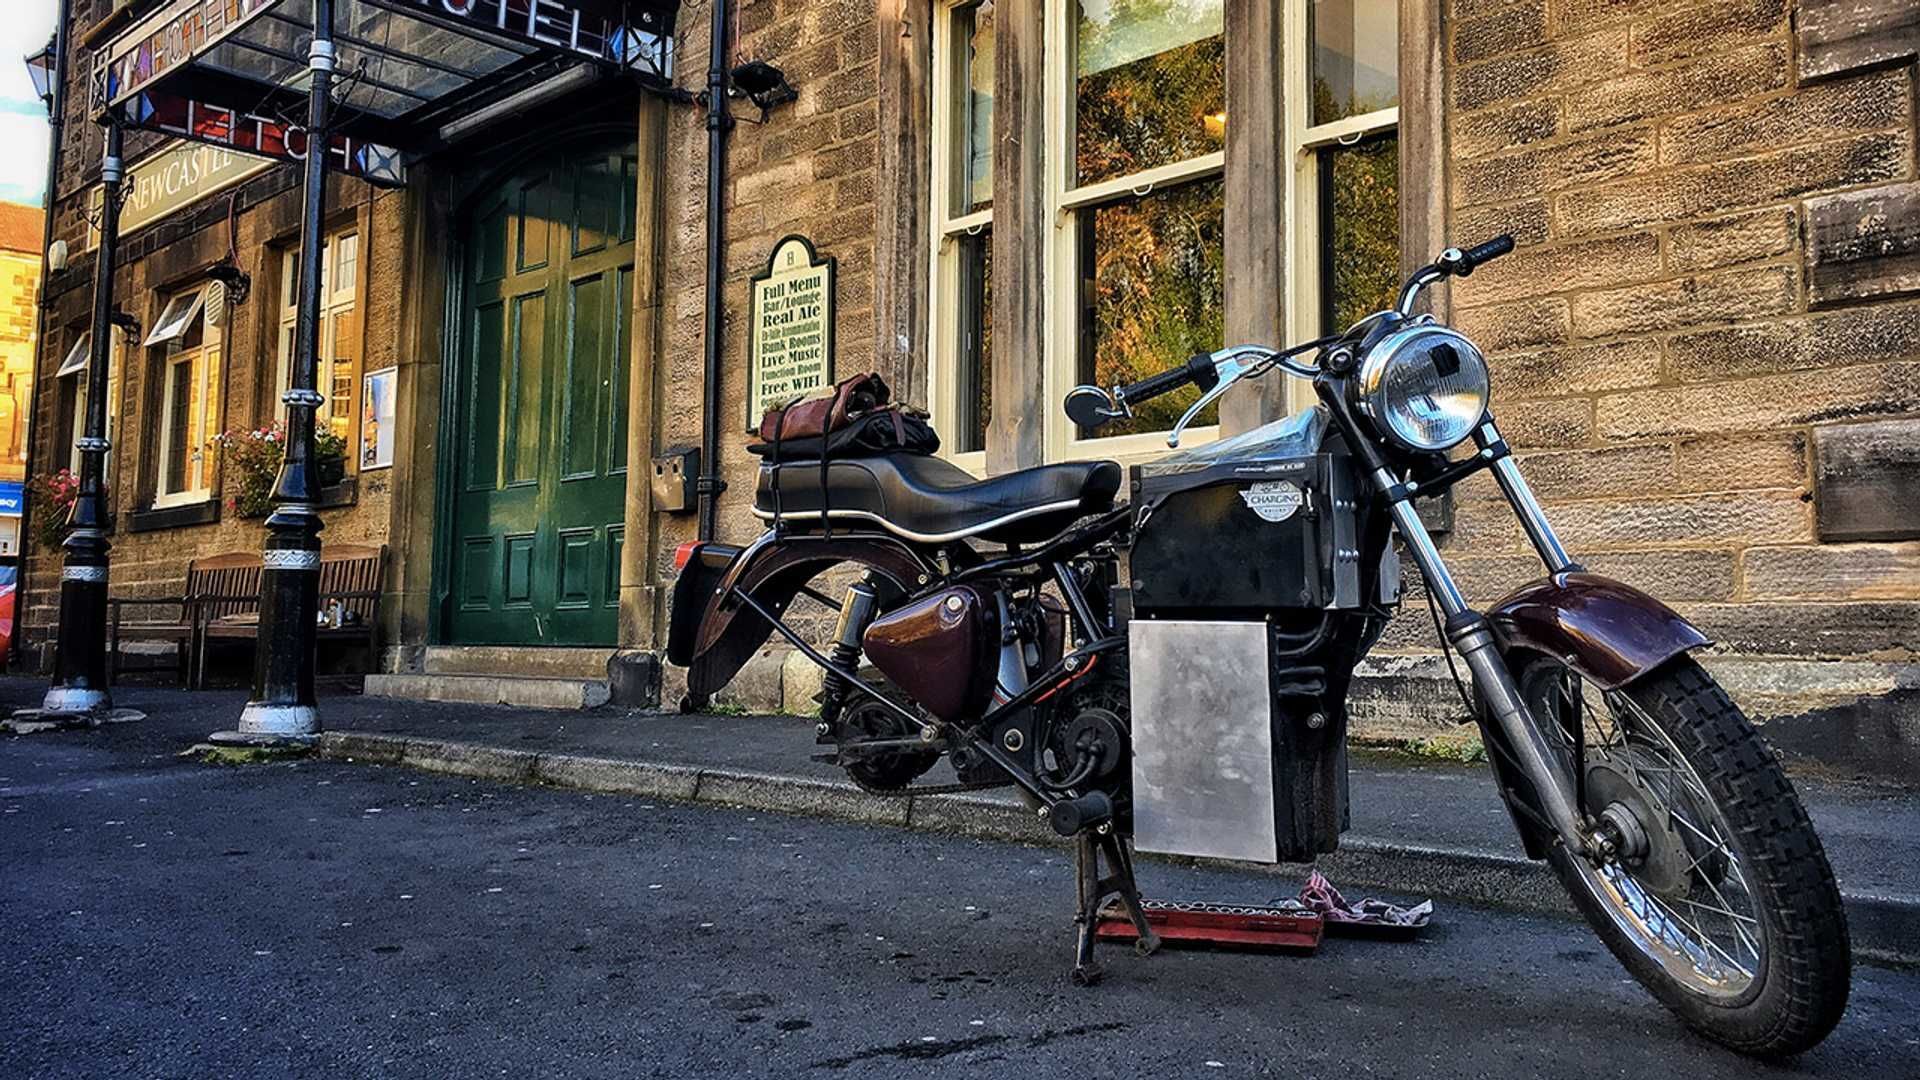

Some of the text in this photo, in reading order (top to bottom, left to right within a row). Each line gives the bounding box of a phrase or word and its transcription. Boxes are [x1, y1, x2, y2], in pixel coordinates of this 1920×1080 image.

[763, 275, 821, 301] Full Menu
[763, 290, 821, 314] Bar/Lounge
[763, 305, 821, 328] Real Ale
[789, 334, 820, 349] Rooms
[761, 347, 820, 368] Live Music
[761, 362, 821, 382] Function Room
[761, 382, 788, 396] Free
[1250, 494, 1301, 505] CHARGING
